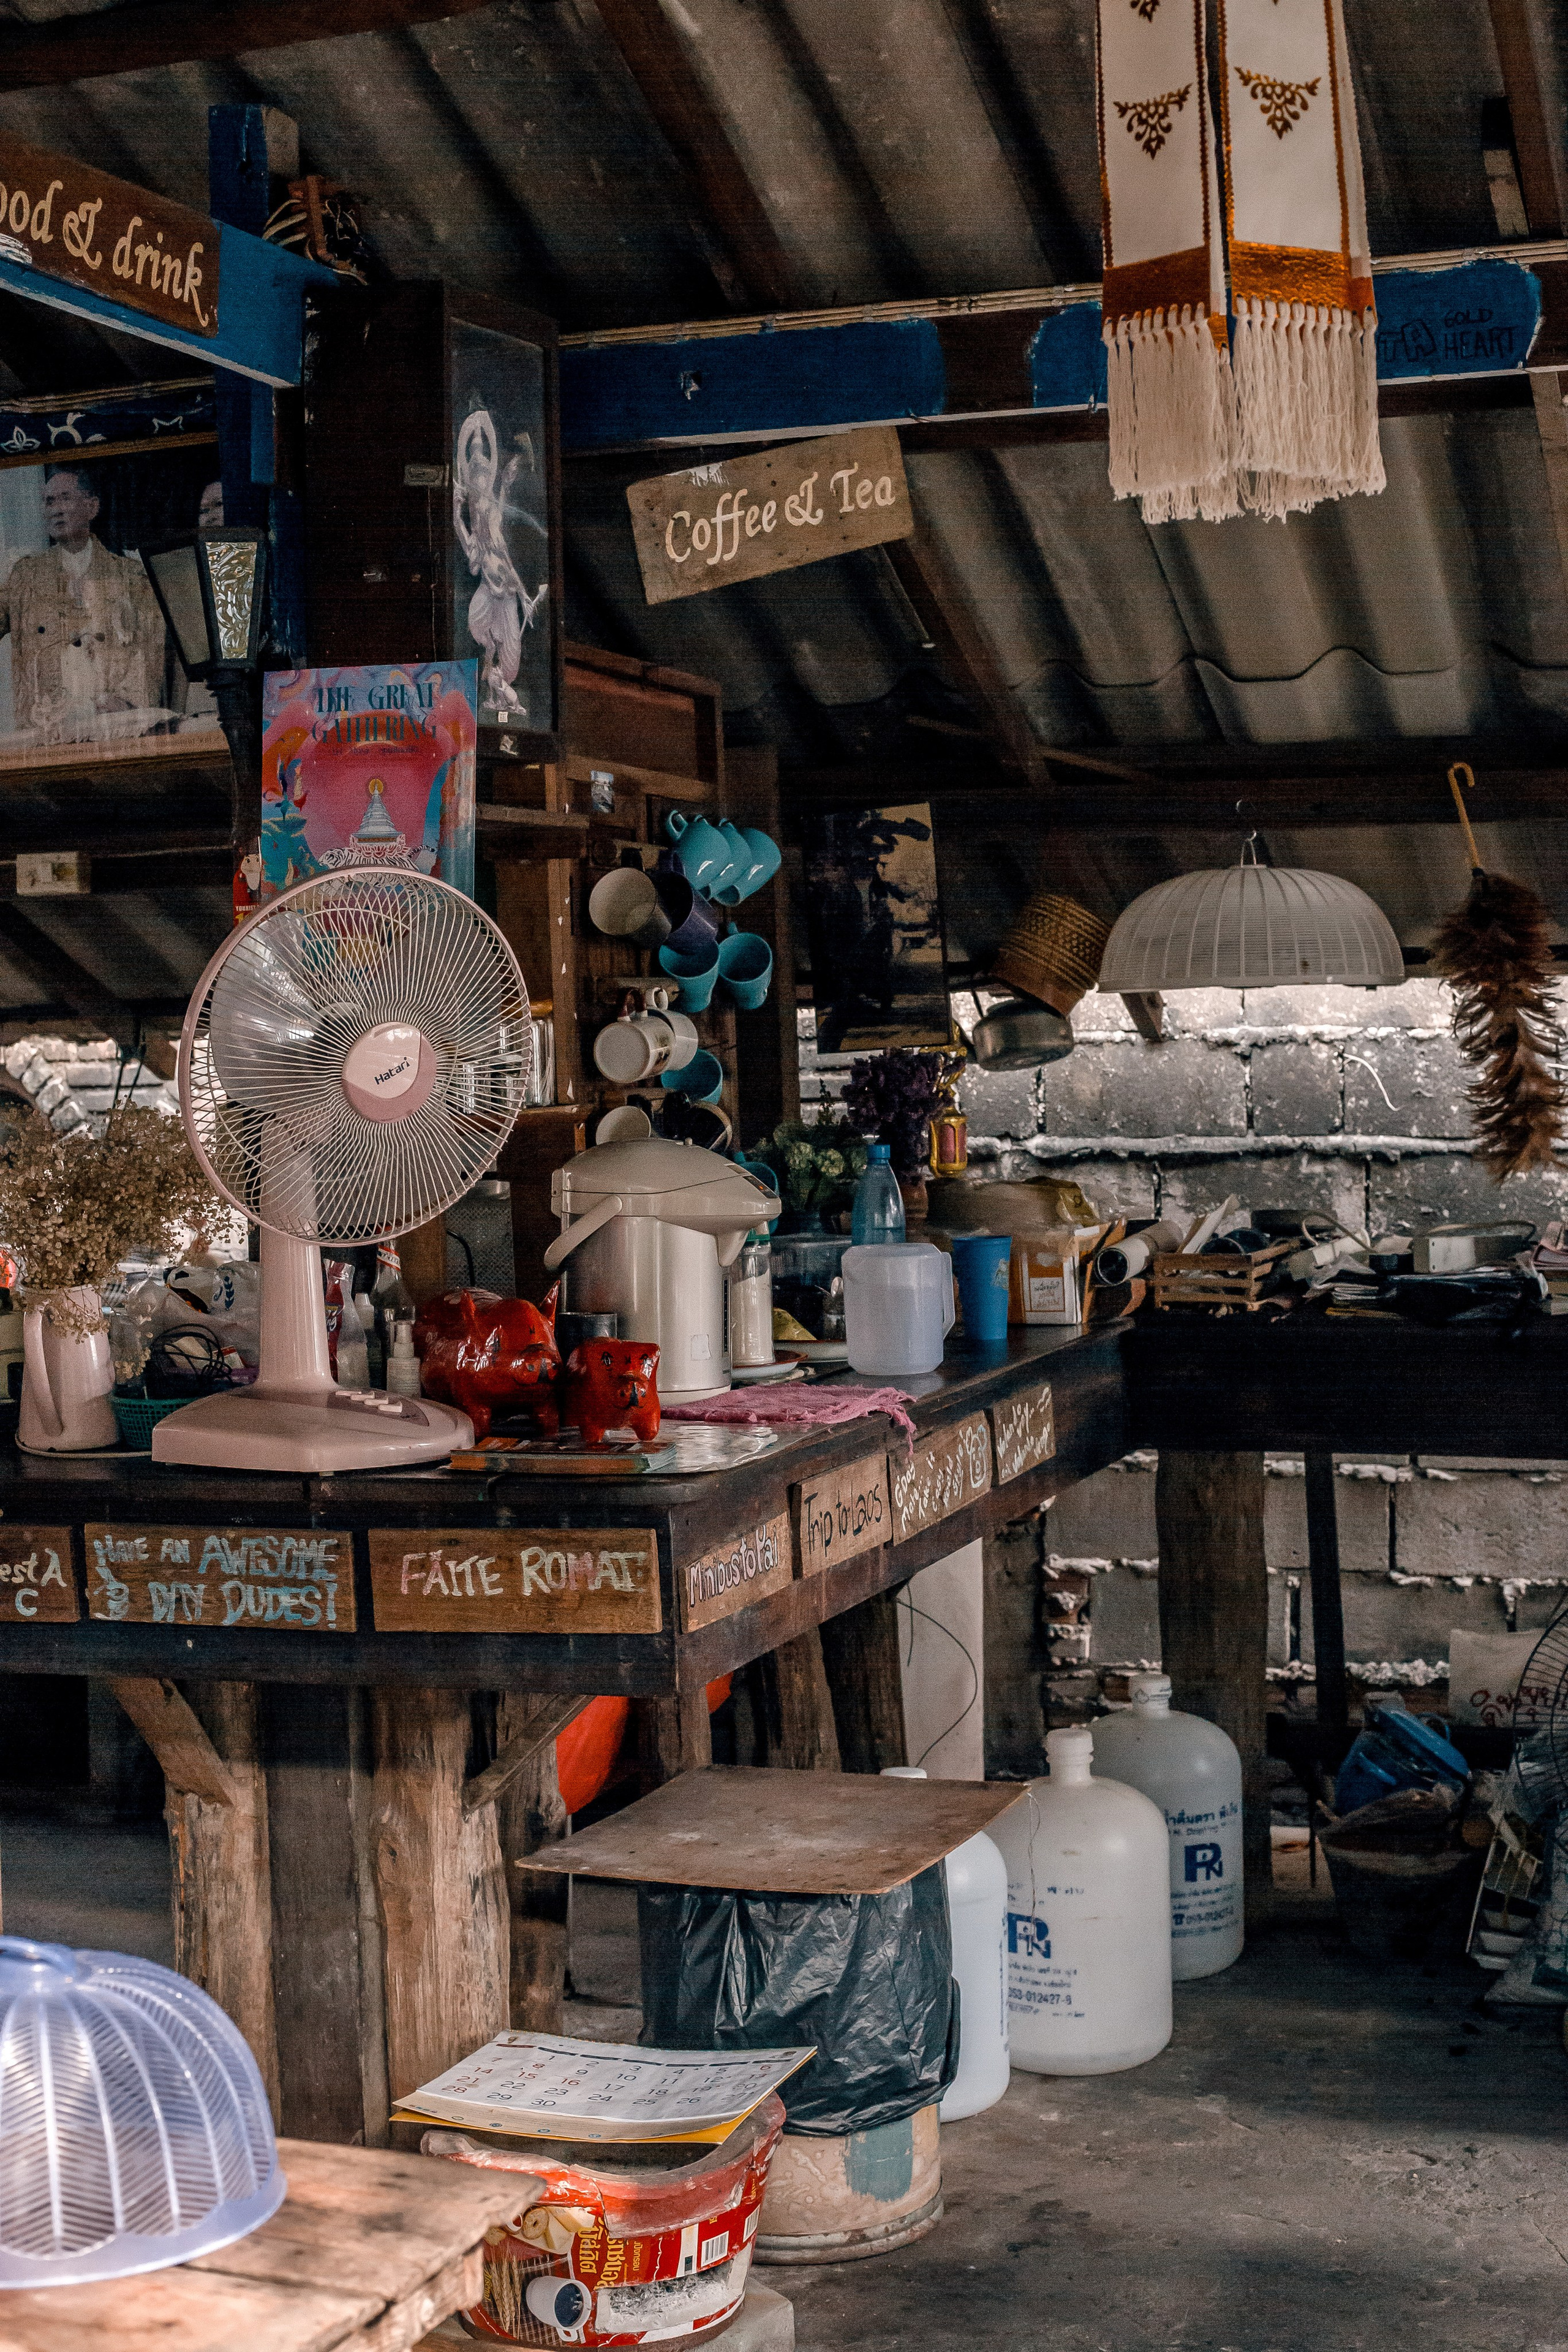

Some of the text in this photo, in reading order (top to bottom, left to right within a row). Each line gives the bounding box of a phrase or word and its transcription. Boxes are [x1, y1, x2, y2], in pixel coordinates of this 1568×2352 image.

[112, 216, 208, 328] drink
[1444, 307, 1493, 328] GOLD
[1444, 326, 1517, 361] HEART
[665, 488, 777, 565] Coffee
[829, 462, 897, 513] Tea
[313, 682, 439, 713] THE GREAT
[312, 713, 437, 744] GATHERING
[374, 1056, 410, 1085] Hatari
[804, 1491, 833, 1558] Trip
[850, 1480, 883, 1537] Laos
[197, 1535, 339, 1581] AWESOME
[689, 1551, 741, 1608] Minibus
[441, 2085, 467, 2094] 28
[500, 2081, 526, 2089] 22
[588, 2094, 612, 2102] 24
[518, 2071, 538, 2079] 15
[561, 2078, 581, 2086] 16
